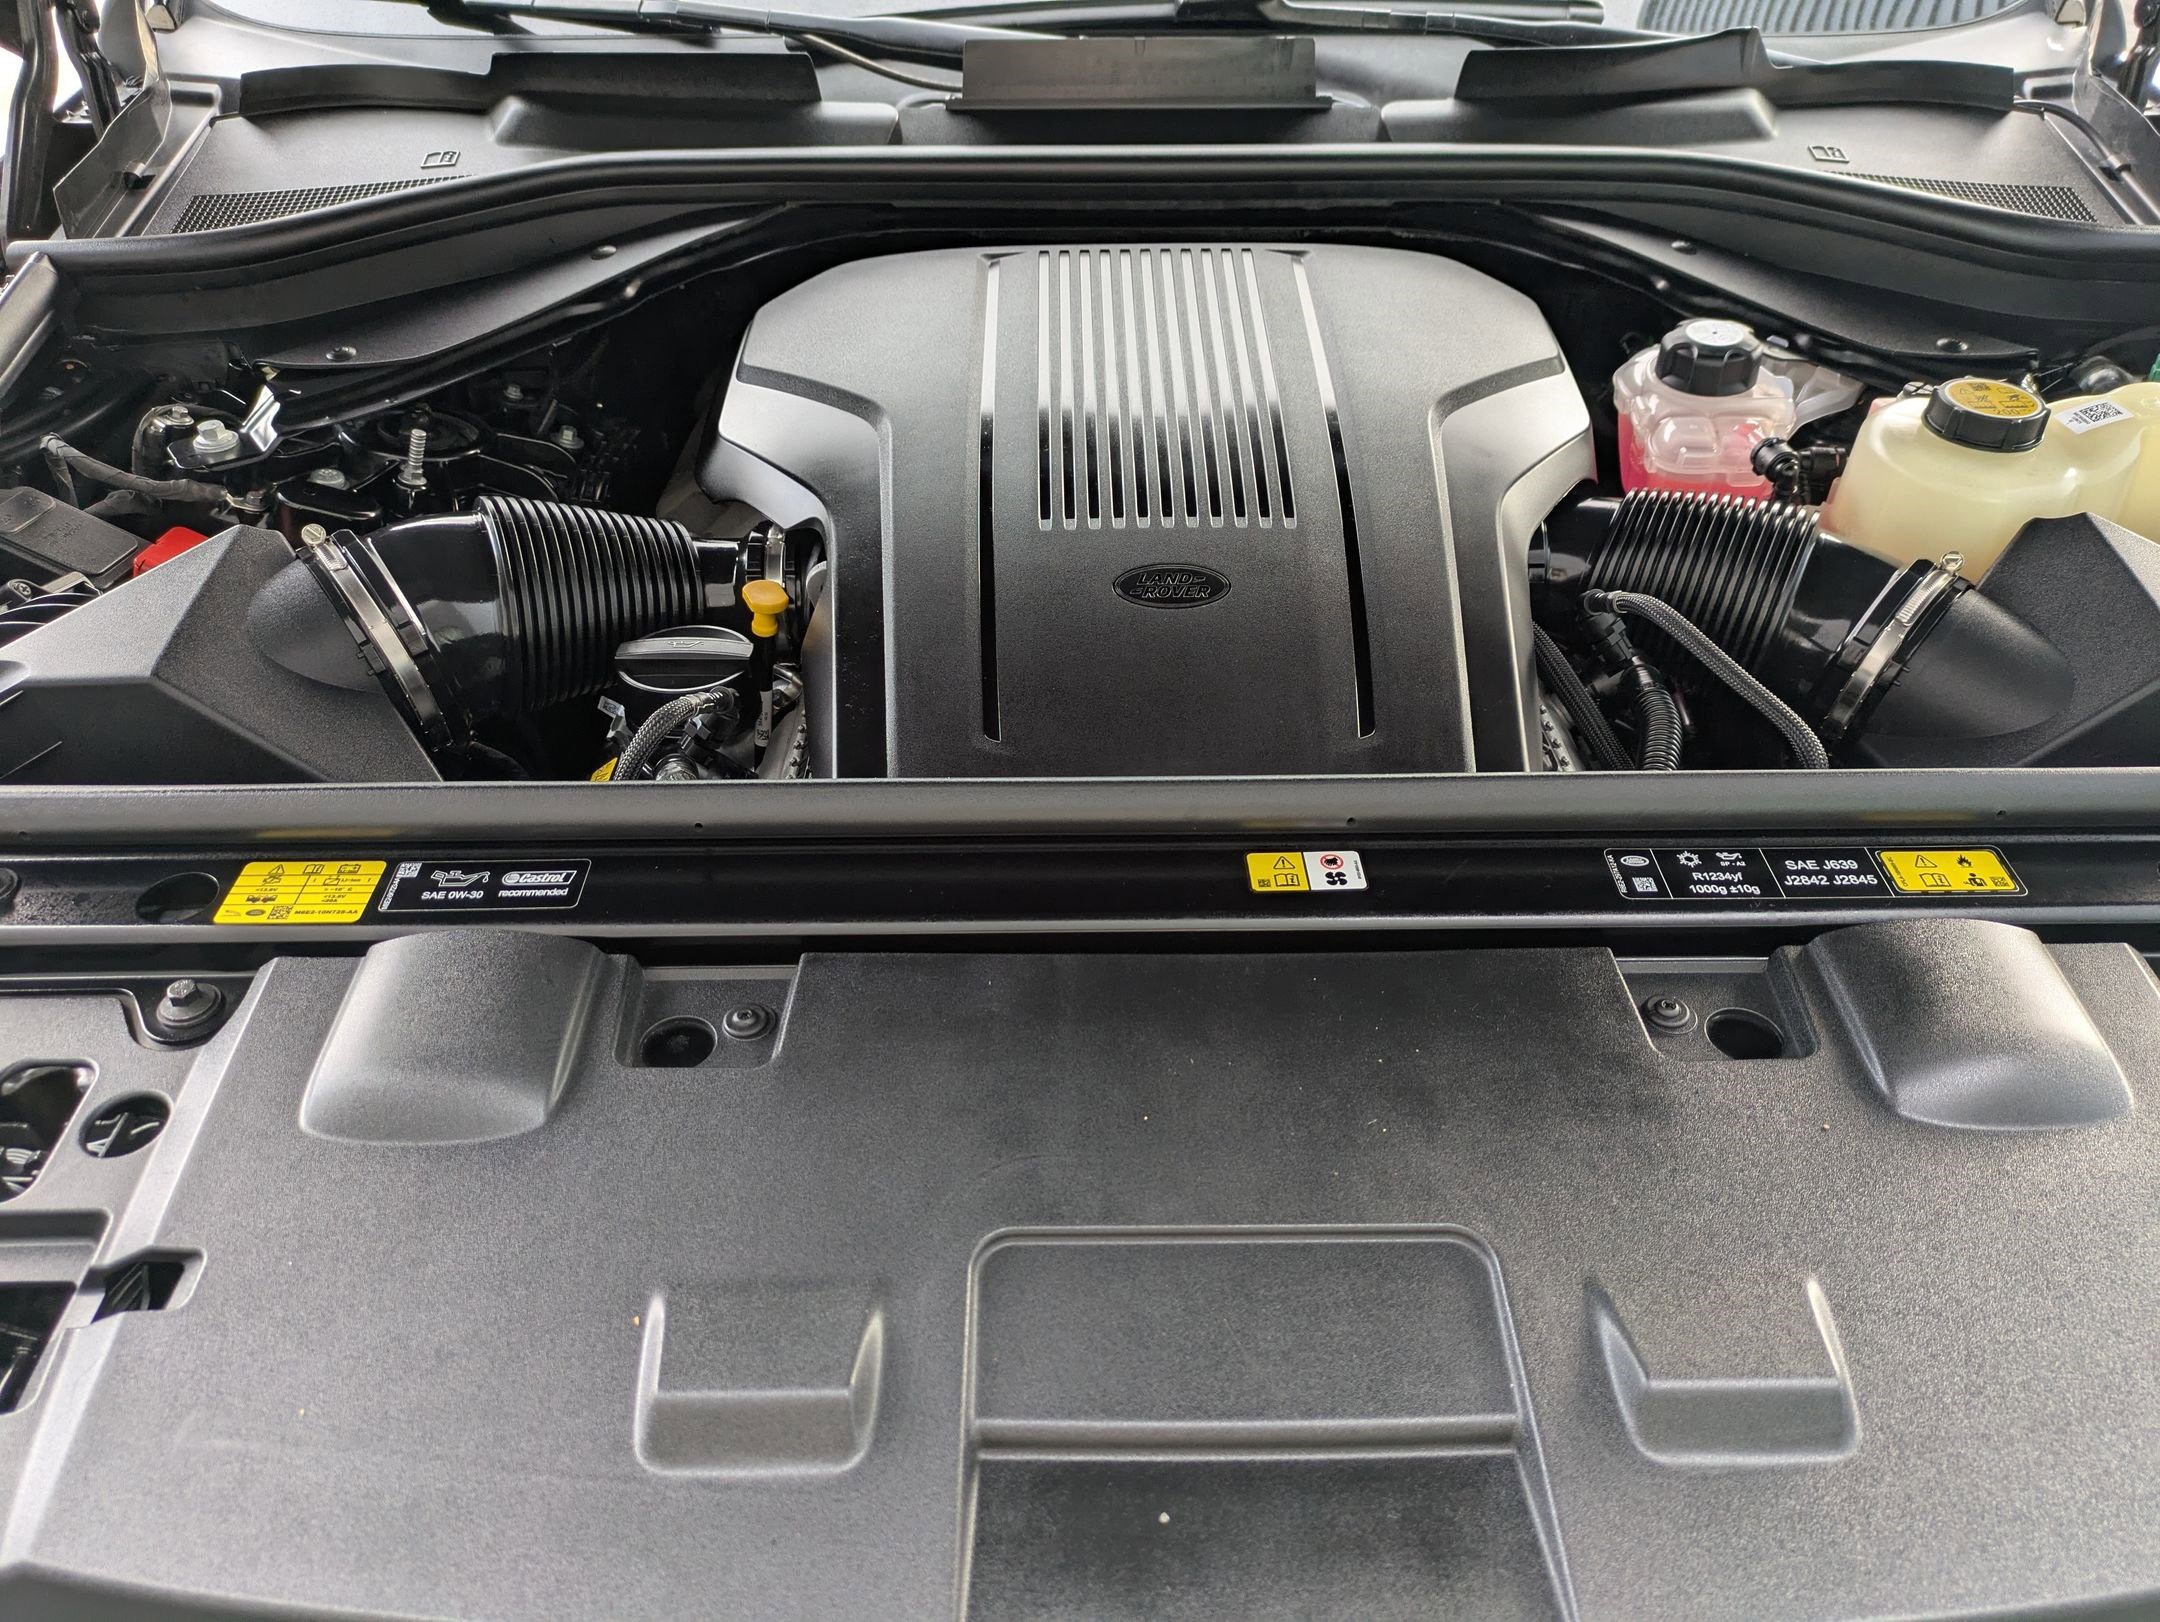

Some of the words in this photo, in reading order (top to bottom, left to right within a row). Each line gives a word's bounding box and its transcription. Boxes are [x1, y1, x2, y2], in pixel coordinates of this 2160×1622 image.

[1137, 573, 1192, 585] LAND
[1141, 585, 1211, 598] ROVER
[1785, 860, 1820, 870] SAE
[1823, 860, 1858, 870] J639
[519, 872, 567, 883] Castrol
[1692, 872, 1743, 882] R1234yf
[1784, 875, 1830, 886] J2842
[1833, 875, 1878, 885] J2845
[421, 891, 445, 900] SAE
[449, 890, 484, 900] 0W-30
[498, 887, 569, 898] recommended
[1689, 885, 1728, 895] 1000g
[1730, 885, 1761, 895] ±10g
